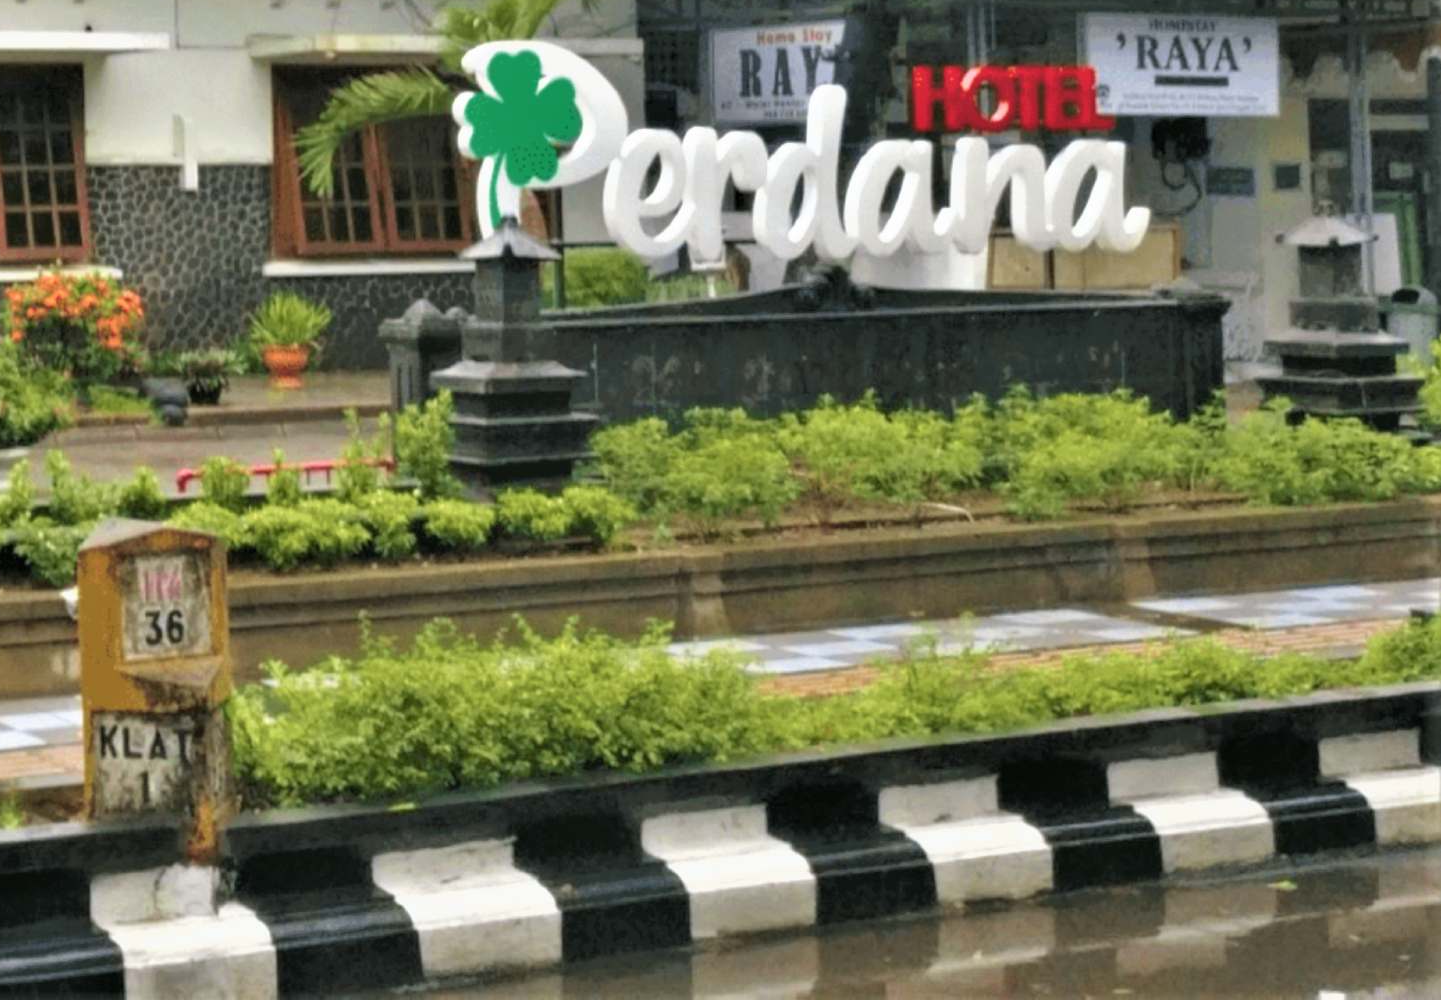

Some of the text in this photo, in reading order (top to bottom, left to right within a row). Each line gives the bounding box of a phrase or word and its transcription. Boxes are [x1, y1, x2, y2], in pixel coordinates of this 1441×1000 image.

[756, 31, 796, 45] Home
[911, 65, 1115, 132] HOTEL
[452, 40, 1151, 259] Perdana
[144, 609, 185, 647] 36
